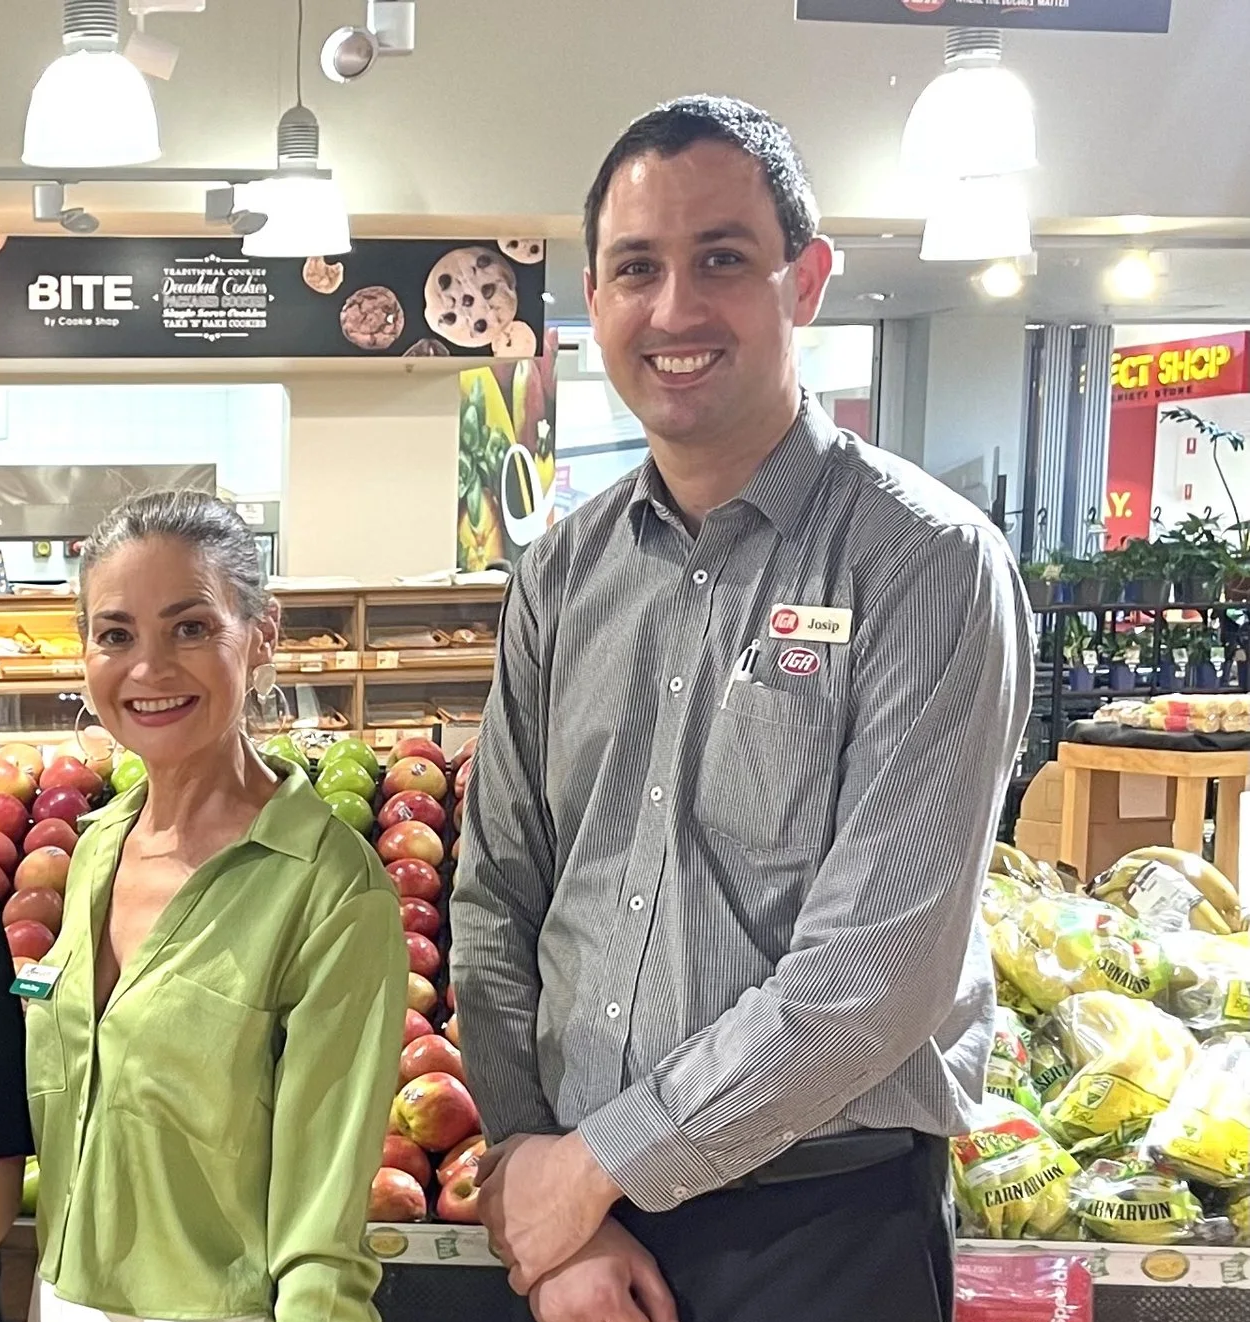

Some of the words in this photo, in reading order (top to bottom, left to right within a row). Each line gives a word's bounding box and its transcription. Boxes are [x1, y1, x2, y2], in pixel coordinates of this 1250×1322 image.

[28, 274, 133, 310] BITE
[222, 274, 267, 296] Cookies
[44, 317, 56, 328] By
[58, 317, 92, 327] Cookie
[95, 317, 120, 327] Shop
[1111, 353, 1154, 389] ECT
[1158, 345, 1231, 385] SHOP
[807, 618, 840, 633] Josip
[781, 651, 816, 672] IGA
[985, 1163, 1065, 1208] CARNARVON
[1085, 1200, 1172, 1221] ARNARVON
